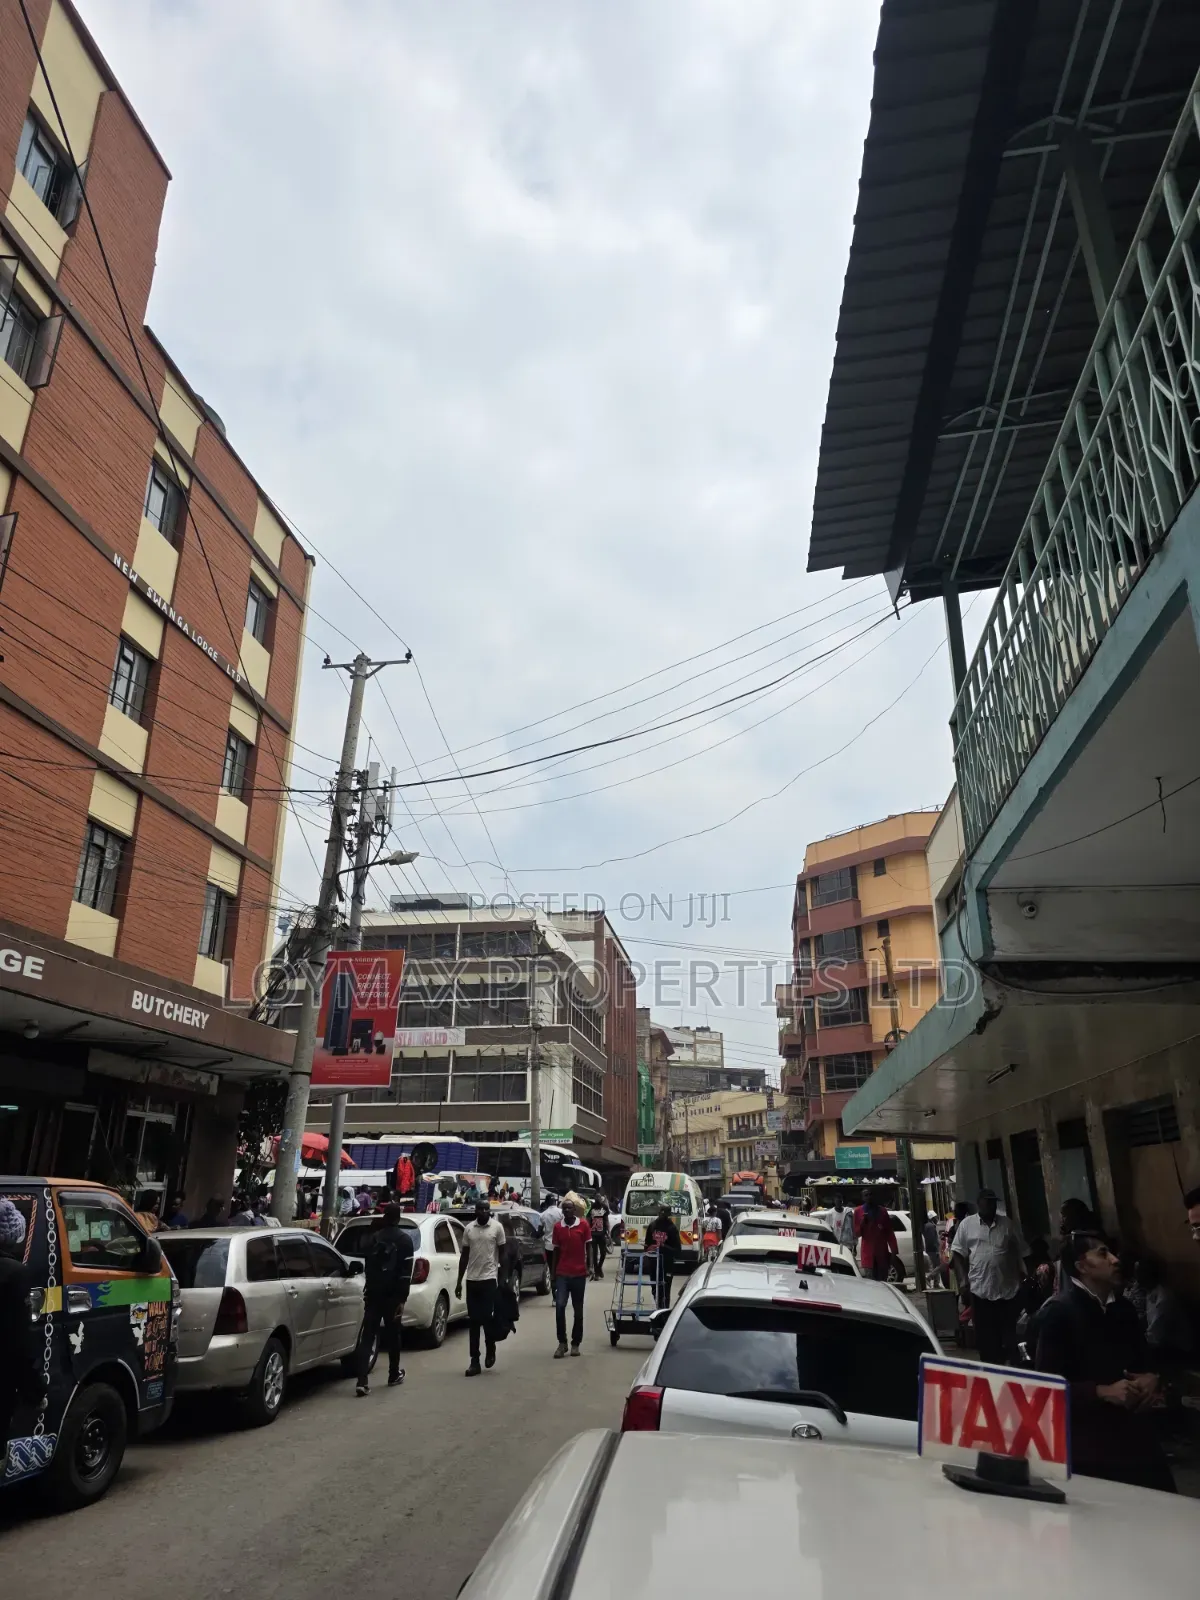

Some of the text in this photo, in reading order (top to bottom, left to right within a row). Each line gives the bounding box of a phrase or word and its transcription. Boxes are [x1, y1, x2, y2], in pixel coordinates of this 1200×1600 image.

[113, 553, 242, 683] NEW SWANGA LODGE LTD
[131, 990, 211, 1030] BUTCHERY
[778, 1227, 797, 1238] TAXI
[800, 1244, 832, 1267] TAXI
[923, 1368, 1067, 1464] TAXI
